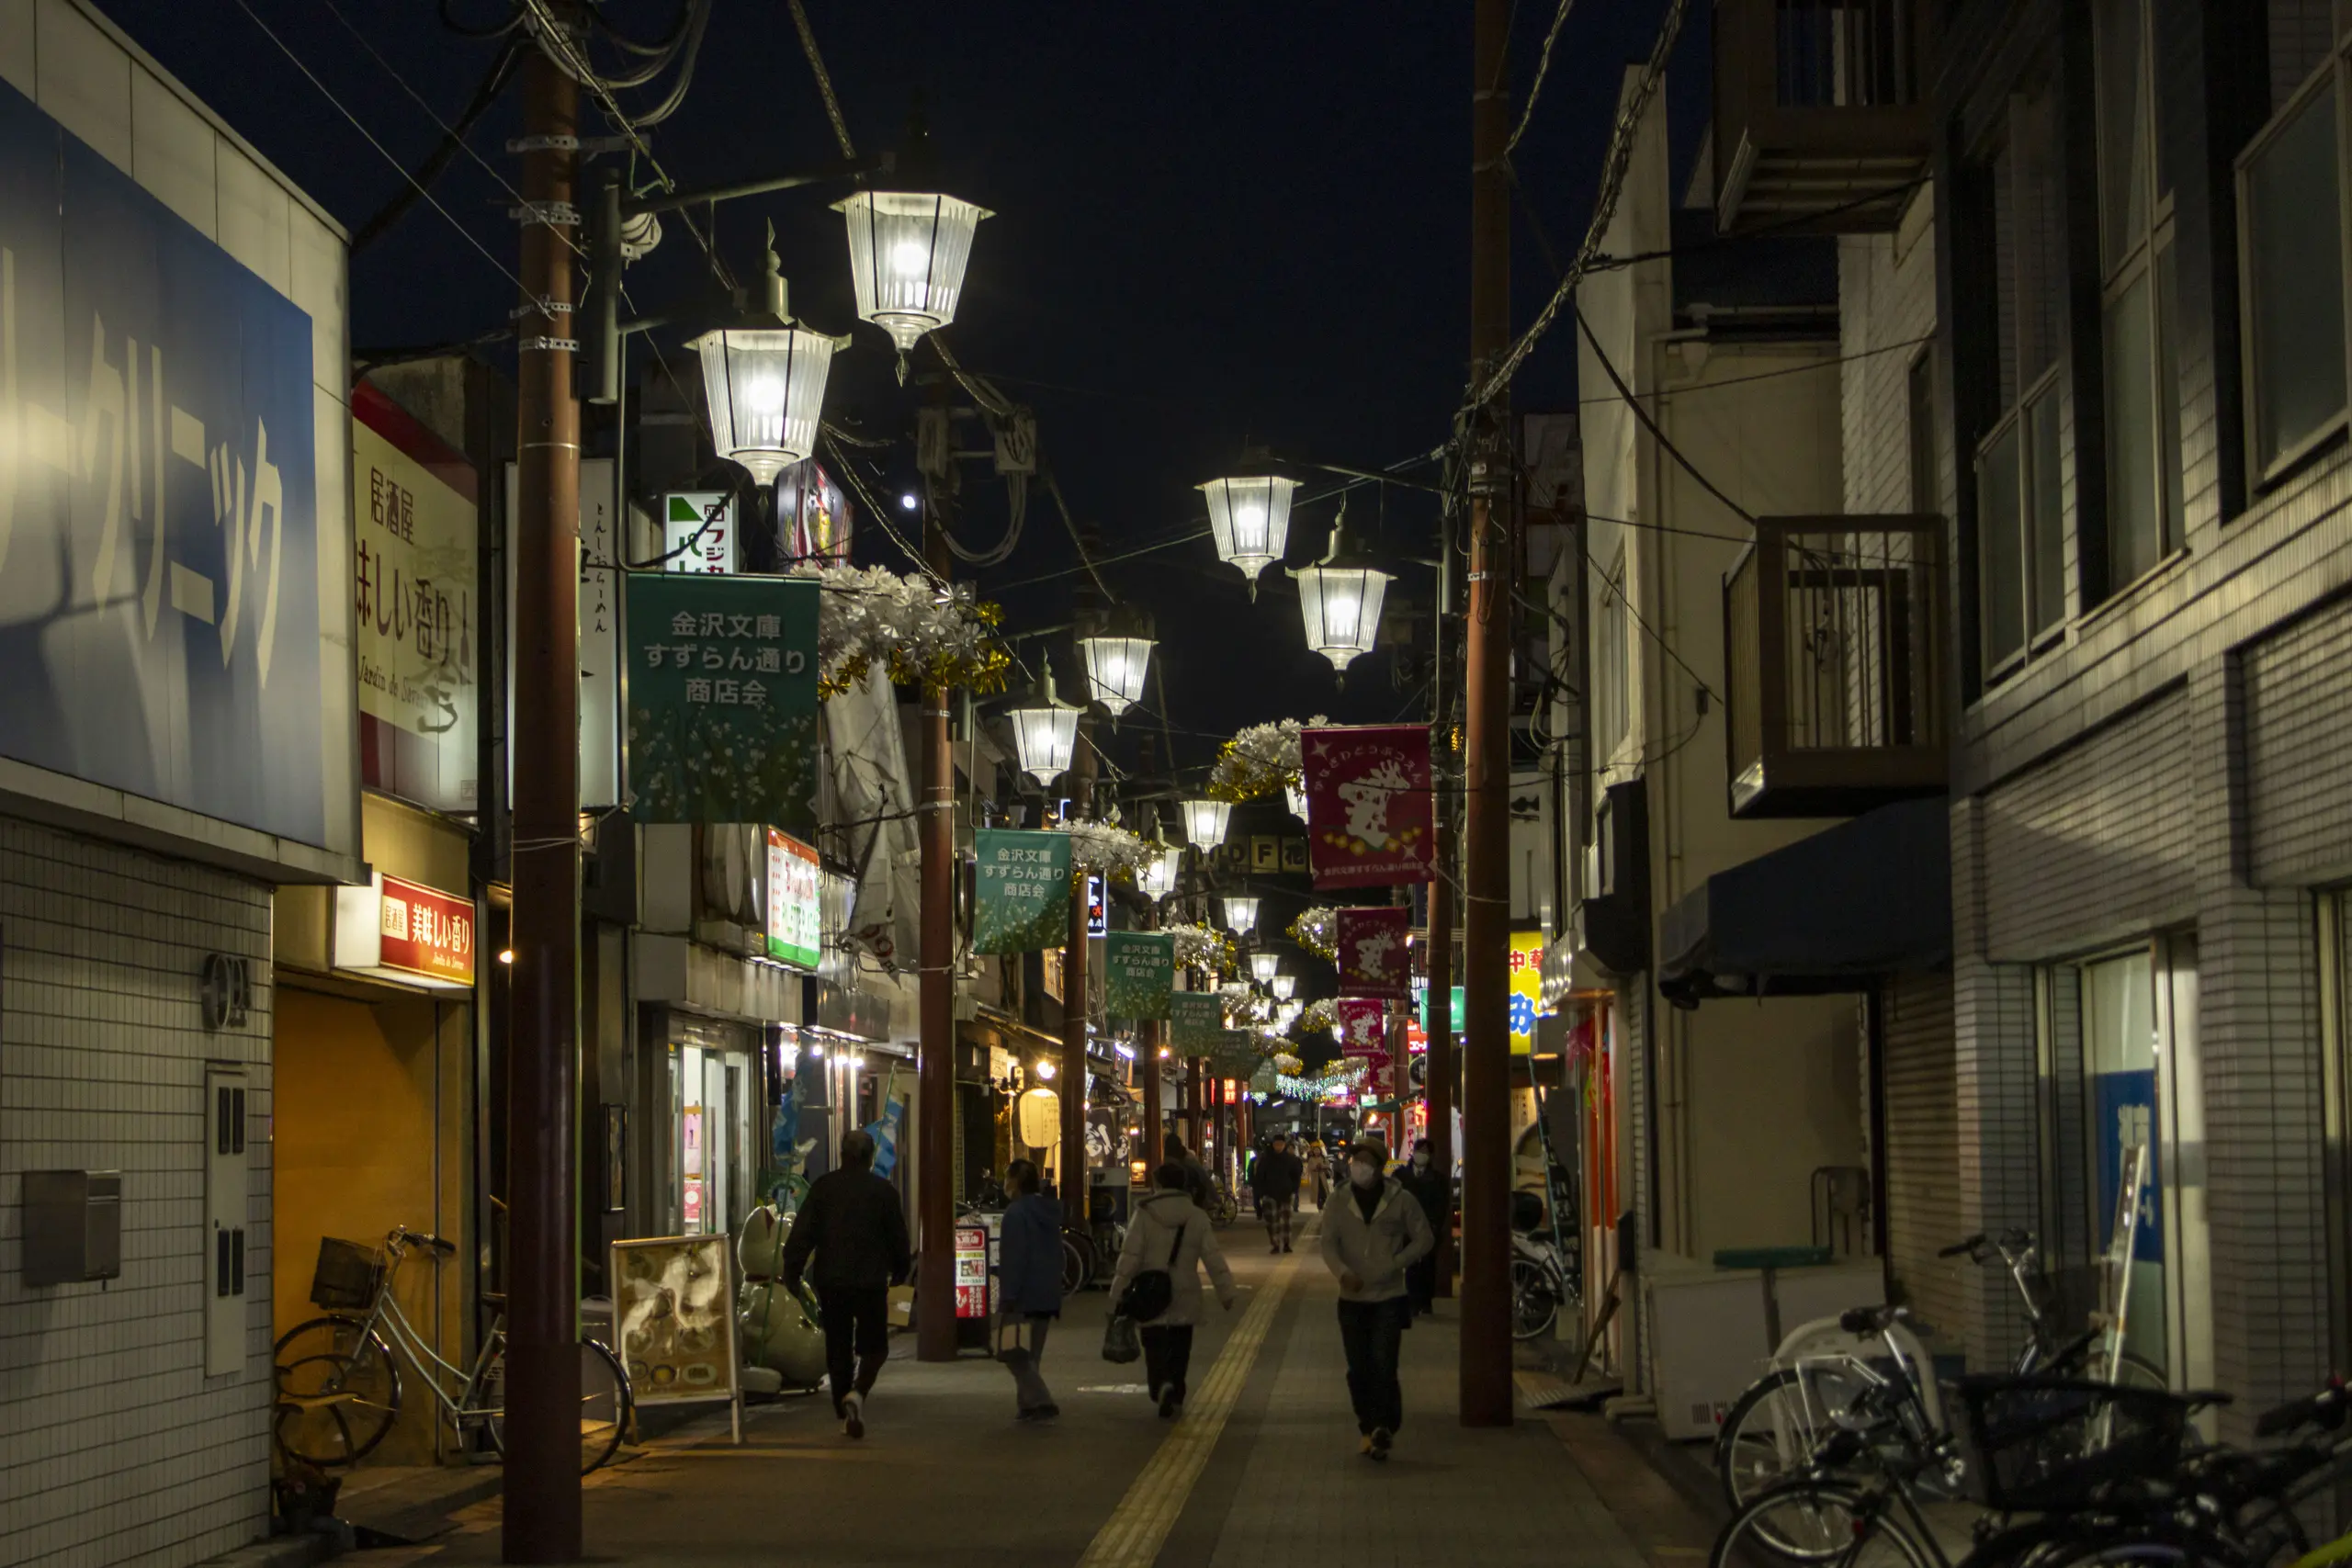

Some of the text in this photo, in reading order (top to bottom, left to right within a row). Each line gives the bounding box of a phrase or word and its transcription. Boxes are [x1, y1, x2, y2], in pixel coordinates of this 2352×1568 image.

[370, 465, 414, 546] 居酒屋
[672, 610, 781, 639] 金沢文庫
[644, 643, 806, 674] すずらん通り
[685, 677, 767, 705] 商店会
[998, 848, 1051, 863] 金沢文庫
[983, 865, 1065, 881] すずらん通り
[1004, 883, 1045, 897] 商店会
[412, 902, 470, 954] 美味しい香り
